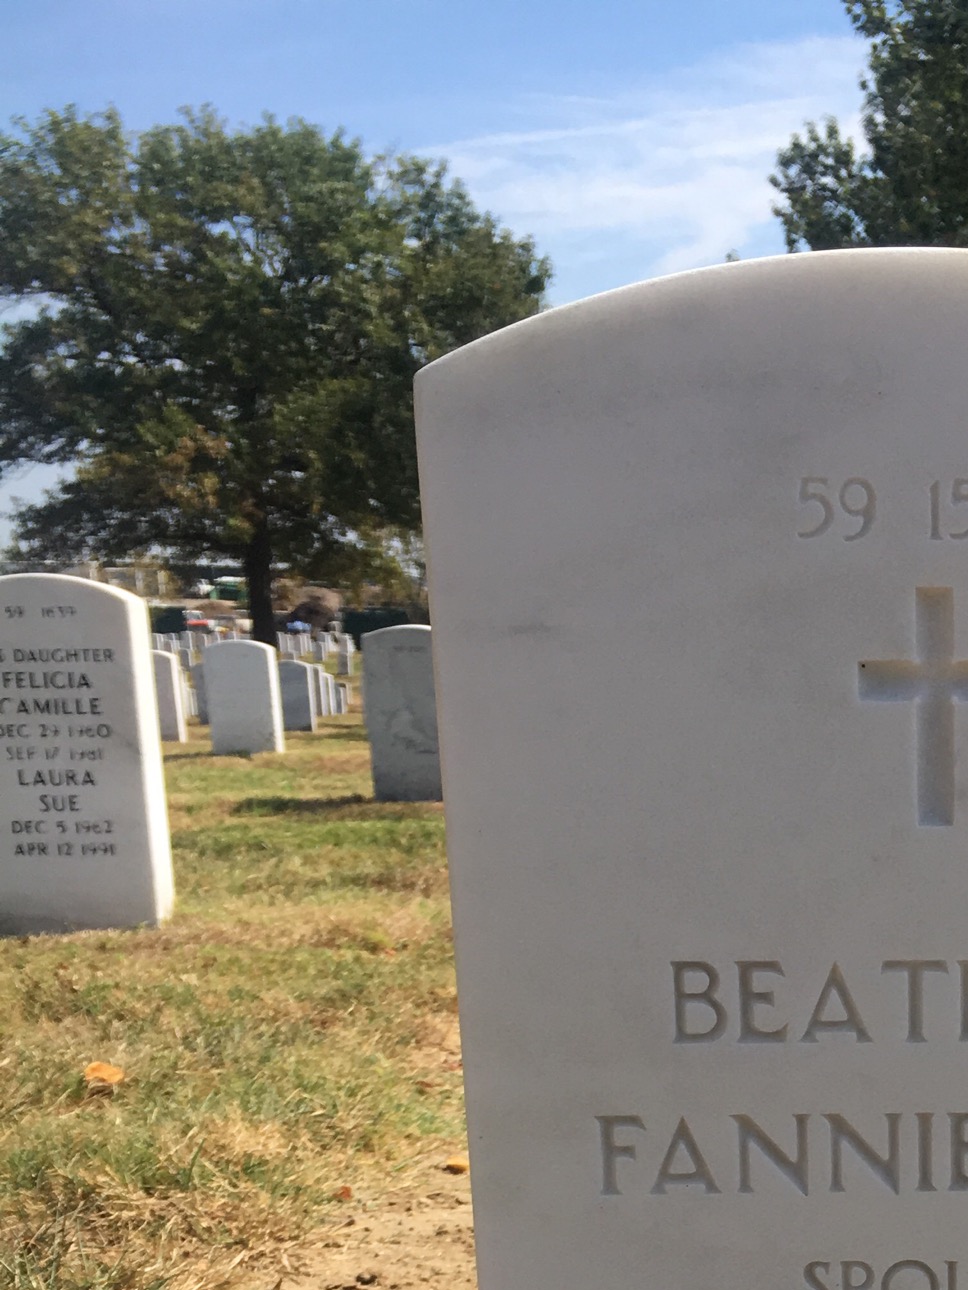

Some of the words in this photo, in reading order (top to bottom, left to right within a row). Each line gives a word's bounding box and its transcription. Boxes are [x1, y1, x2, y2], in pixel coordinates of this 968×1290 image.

[797, 475, 877, 542] 59
[13, 648, 115, 662] DAUGHTER
[2, 671, 92, 689] FELICIA
[0, 697, 103, 715] CAMILLE
[6, 746, 36, 760] SEP
[17, 769, 97, 787] LAURA
[39, 794, 81, 812] SUE
[11, 820, 47, 834] DEC
[56, 820, 68, 834] 5
[14, 842, 49, 856] APR
[56, 841, 74, 856] 12
[81, 842, 117, 856] 1991
